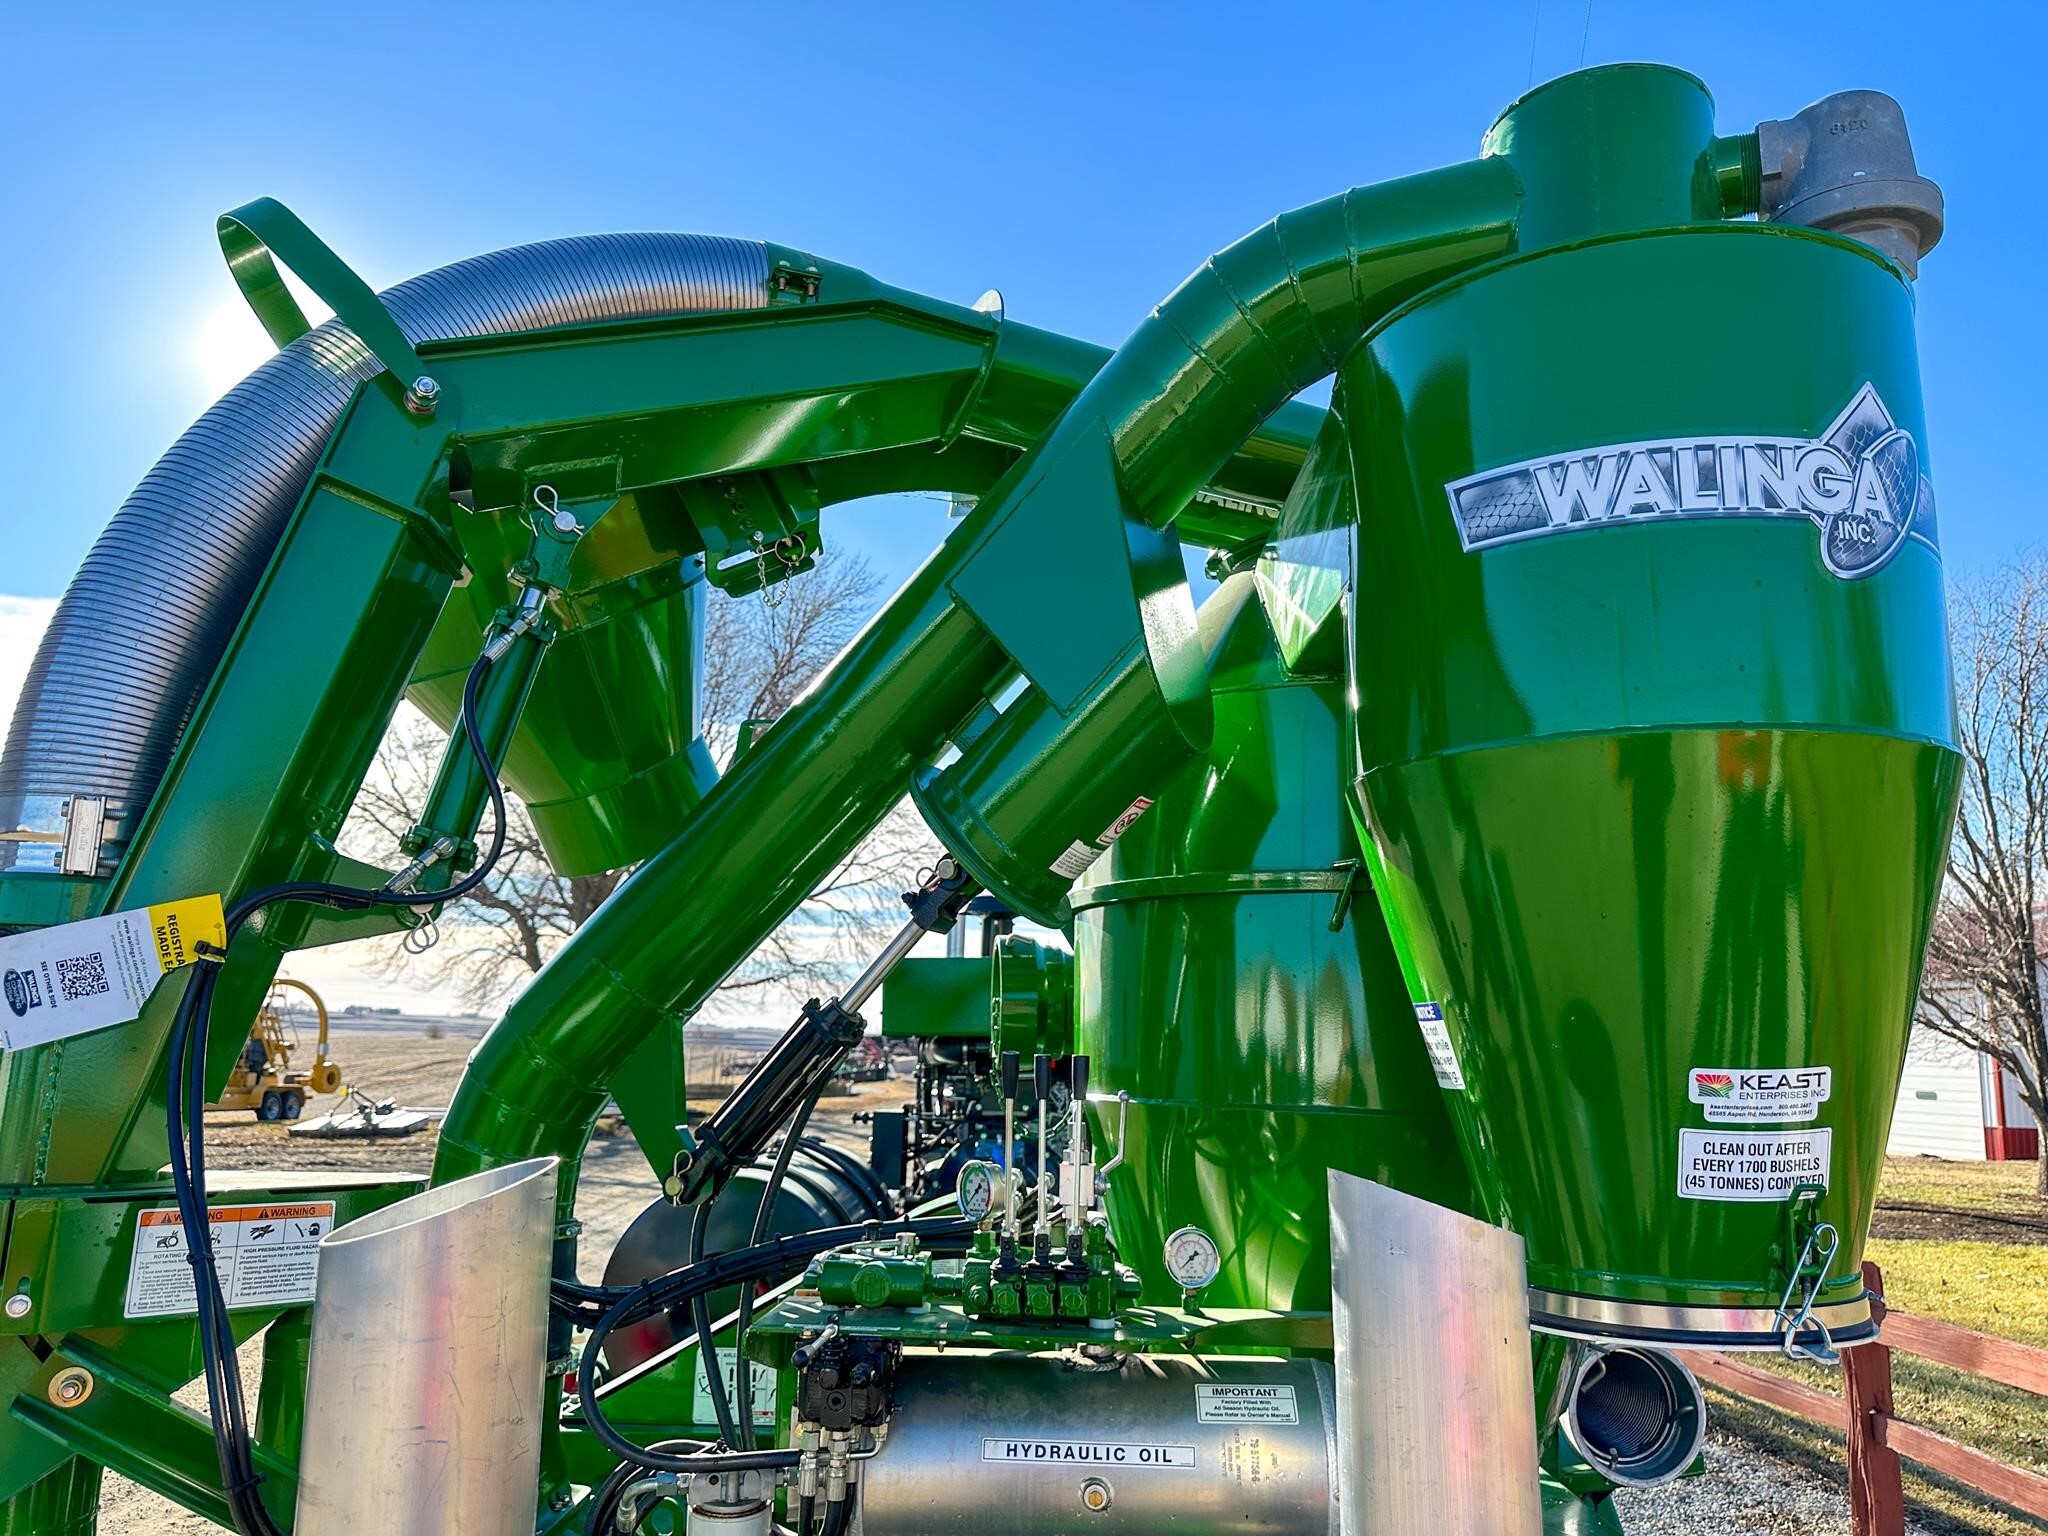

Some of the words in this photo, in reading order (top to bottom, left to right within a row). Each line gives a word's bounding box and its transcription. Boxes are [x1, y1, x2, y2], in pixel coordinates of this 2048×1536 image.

[1530, 443, 1895, 528] WALINGA
[1837, 518, 1876, 545] INC.
[157, 926, 171, 958] MADE
[27, 974, 40, 1004] WALINGA
[44, 973, 54, 994] OTHER
[49, 994, 57, 1008] SIDE
[1739, 1072, 1826, 1090] KEAST
[1739, 1091, 1808, 1100] ENTERPRISES
[1810, 1089, 1825, 1097] INC
[1704, 1142, 1744, 1155] CLEAN
[1748, 1144, 1773, 1156] OUT
[1776, 1142, 1811, 1155] AFTER
[1693, 1158, 1734, 1172] EVERY
[1739, 1161, 1766, 1173] 1700
[1771, 1158, 1819, 1172] BUSHELS
[1685, 1174, 1705, 1189] (45
[1709, 1177, 1764, 1192] TONNES)
[271, 1207, 316, 1217] WARNING
[1212, 1388, 1277, 1396] IMPORTANT
[1006, 1443, 1126, 1461] HYDRAULIC
[1139, 1449, 1172, 1463] OIL
